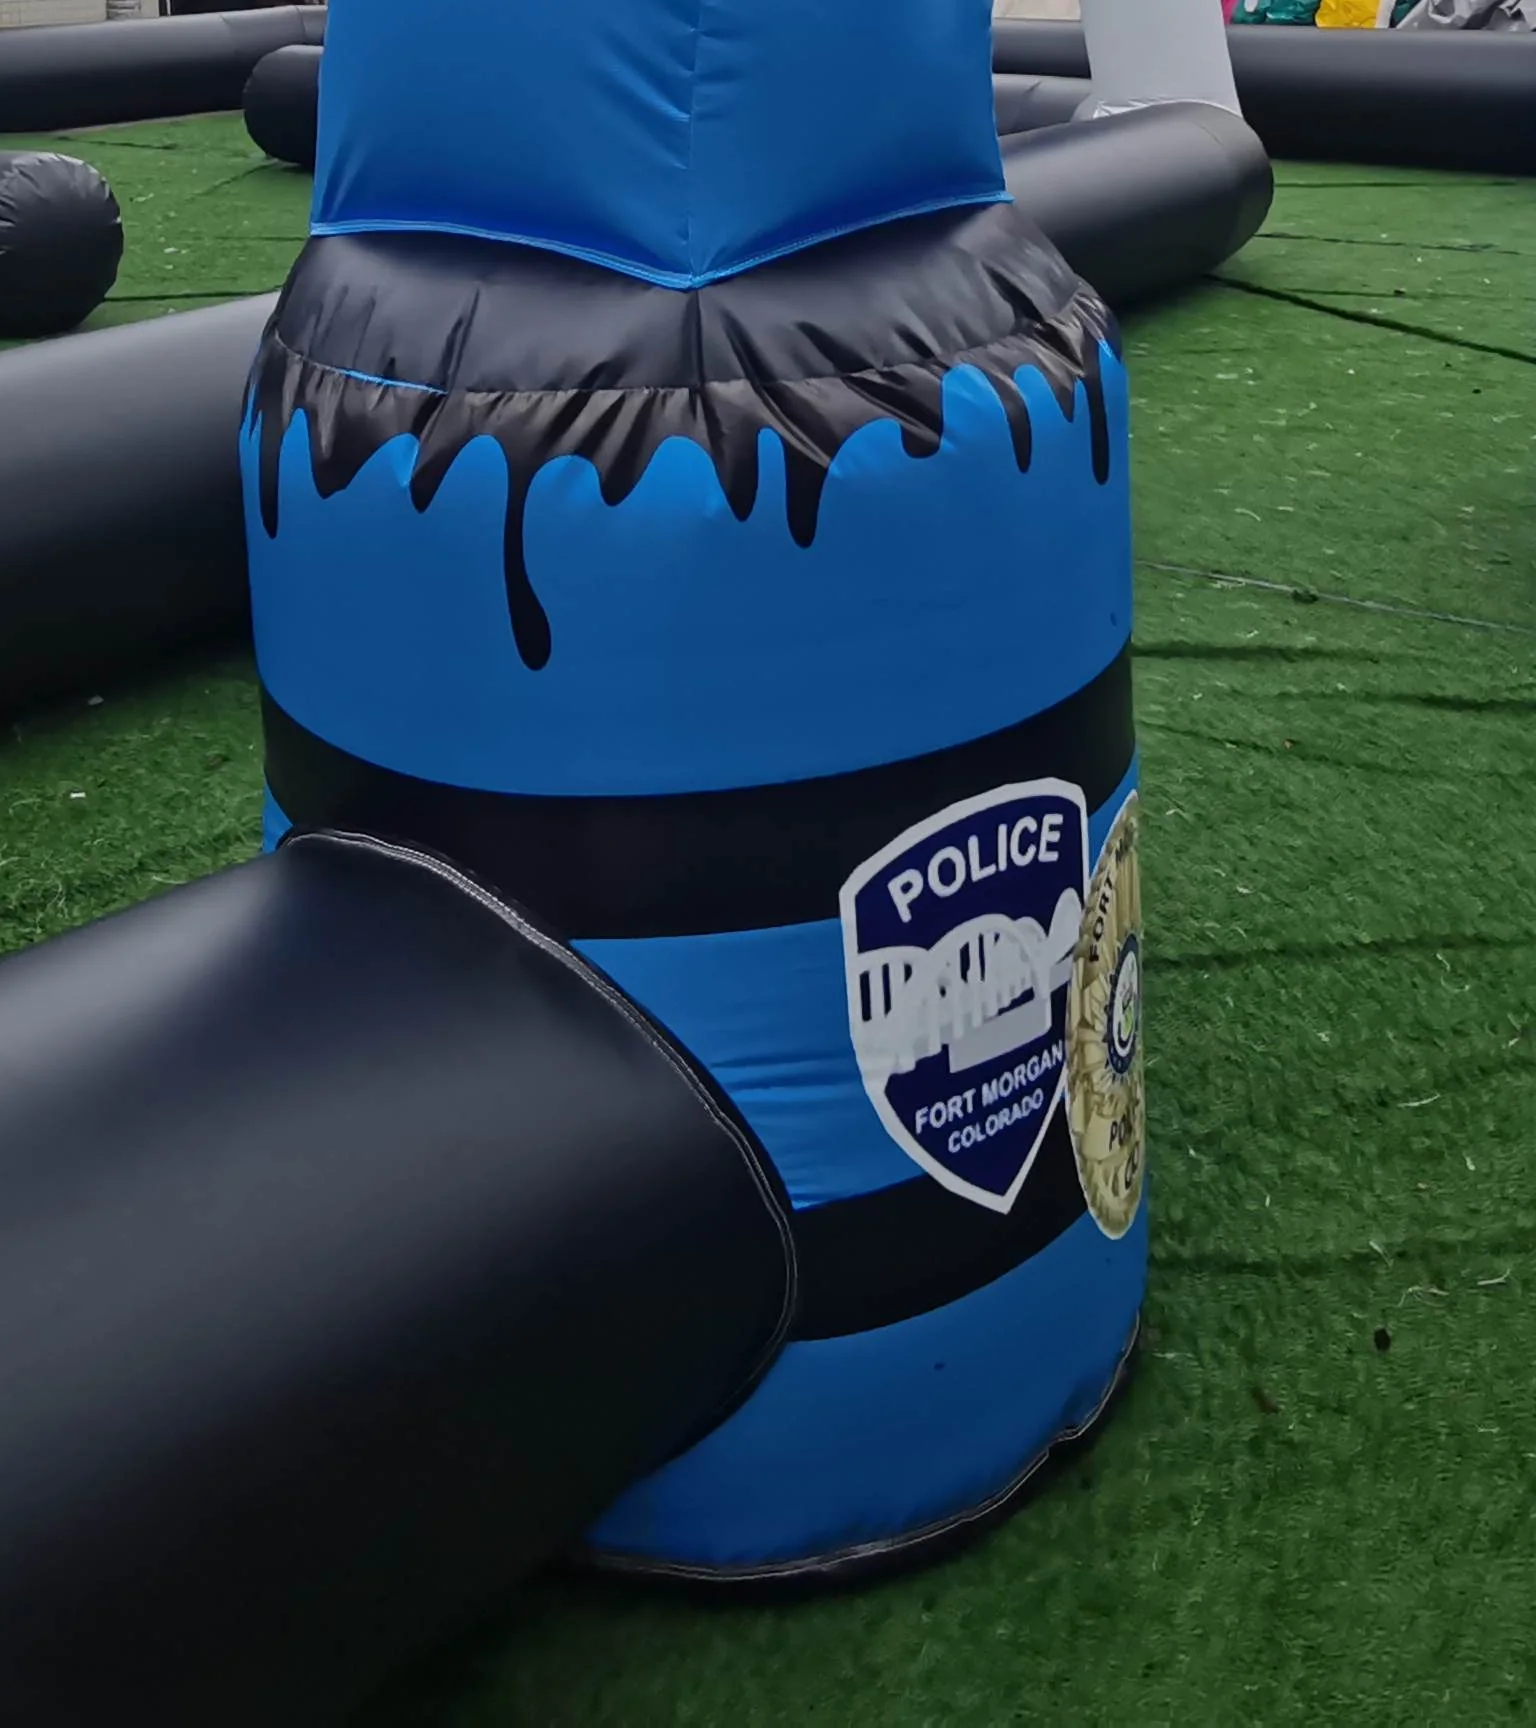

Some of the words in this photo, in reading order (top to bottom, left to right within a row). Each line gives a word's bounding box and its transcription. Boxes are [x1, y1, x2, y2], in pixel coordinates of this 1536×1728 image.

[887, 812, 1064, 924] POLICE
[915, 1087, 976, 1135] FORT
[981, 1039, 1063, 1107] MORGAN
[948, 1087, 1044, 1153] COLORADO
